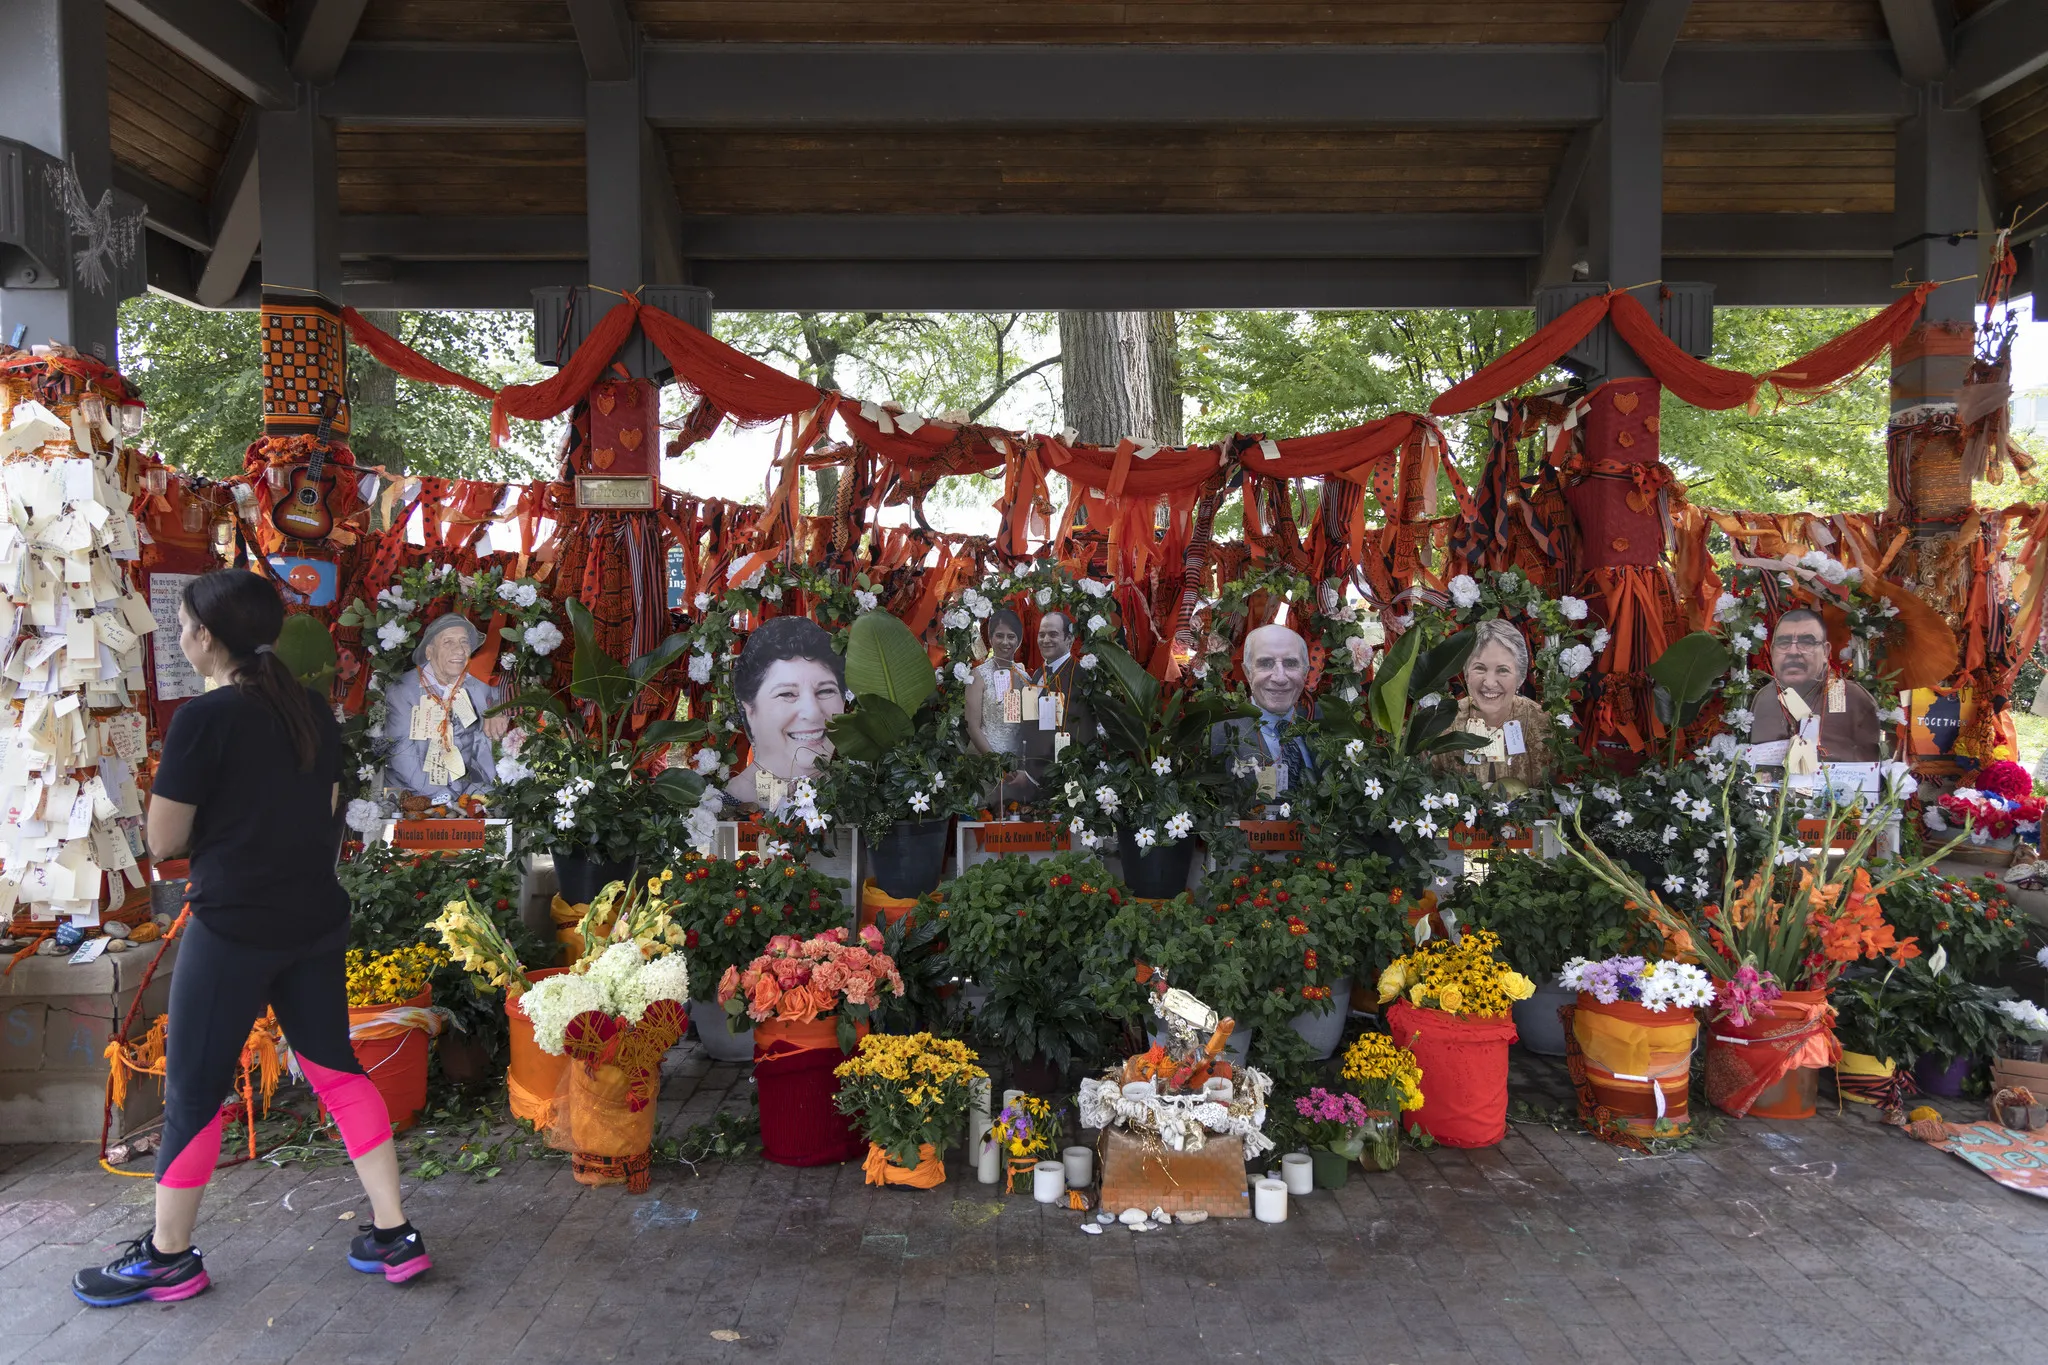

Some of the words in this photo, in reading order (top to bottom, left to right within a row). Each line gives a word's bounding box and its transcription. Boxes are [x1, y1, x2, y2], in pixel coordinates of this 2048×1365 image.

[397, 828, 424, 841] Nicolas
[739, 831, 761, 842] Jac
[1005, 831, 1012, 842] &
[1013, 831, 1033, 842] Kevin
[1243, 829, 1285, 843] tephen
[1289, 829, 1308, 840] Str
